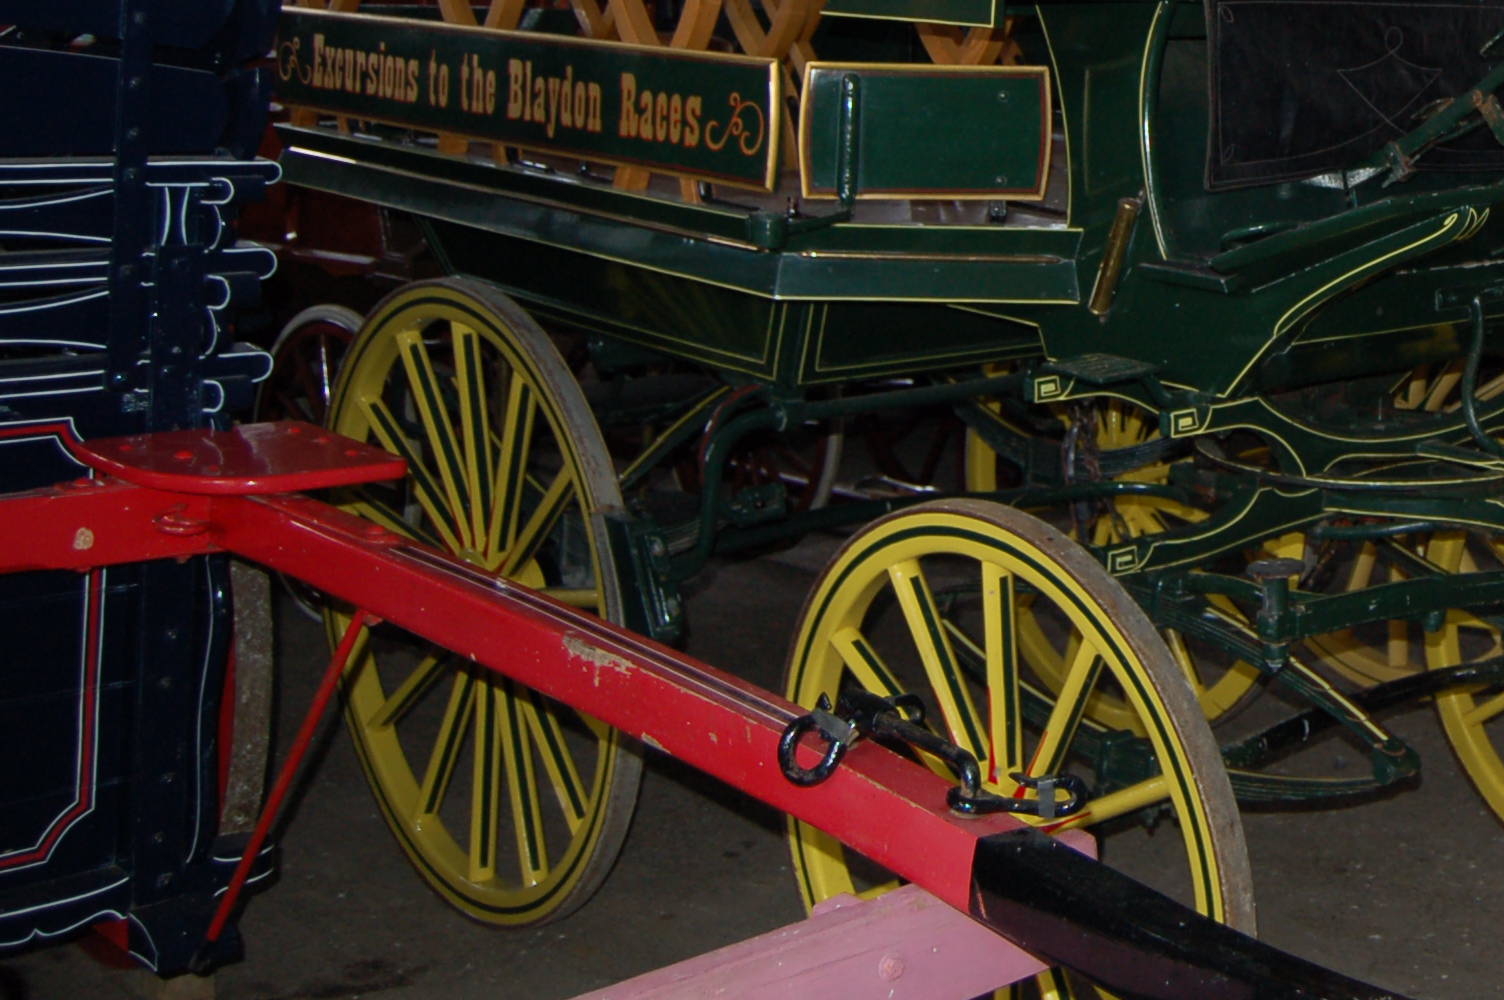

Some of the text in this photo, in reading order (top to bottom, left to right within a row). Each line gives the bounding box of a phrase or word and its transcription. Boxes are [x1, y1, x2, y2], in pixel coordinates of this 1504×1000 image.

[311, 32, 703, 149] Excursions to the Blaydon Races
